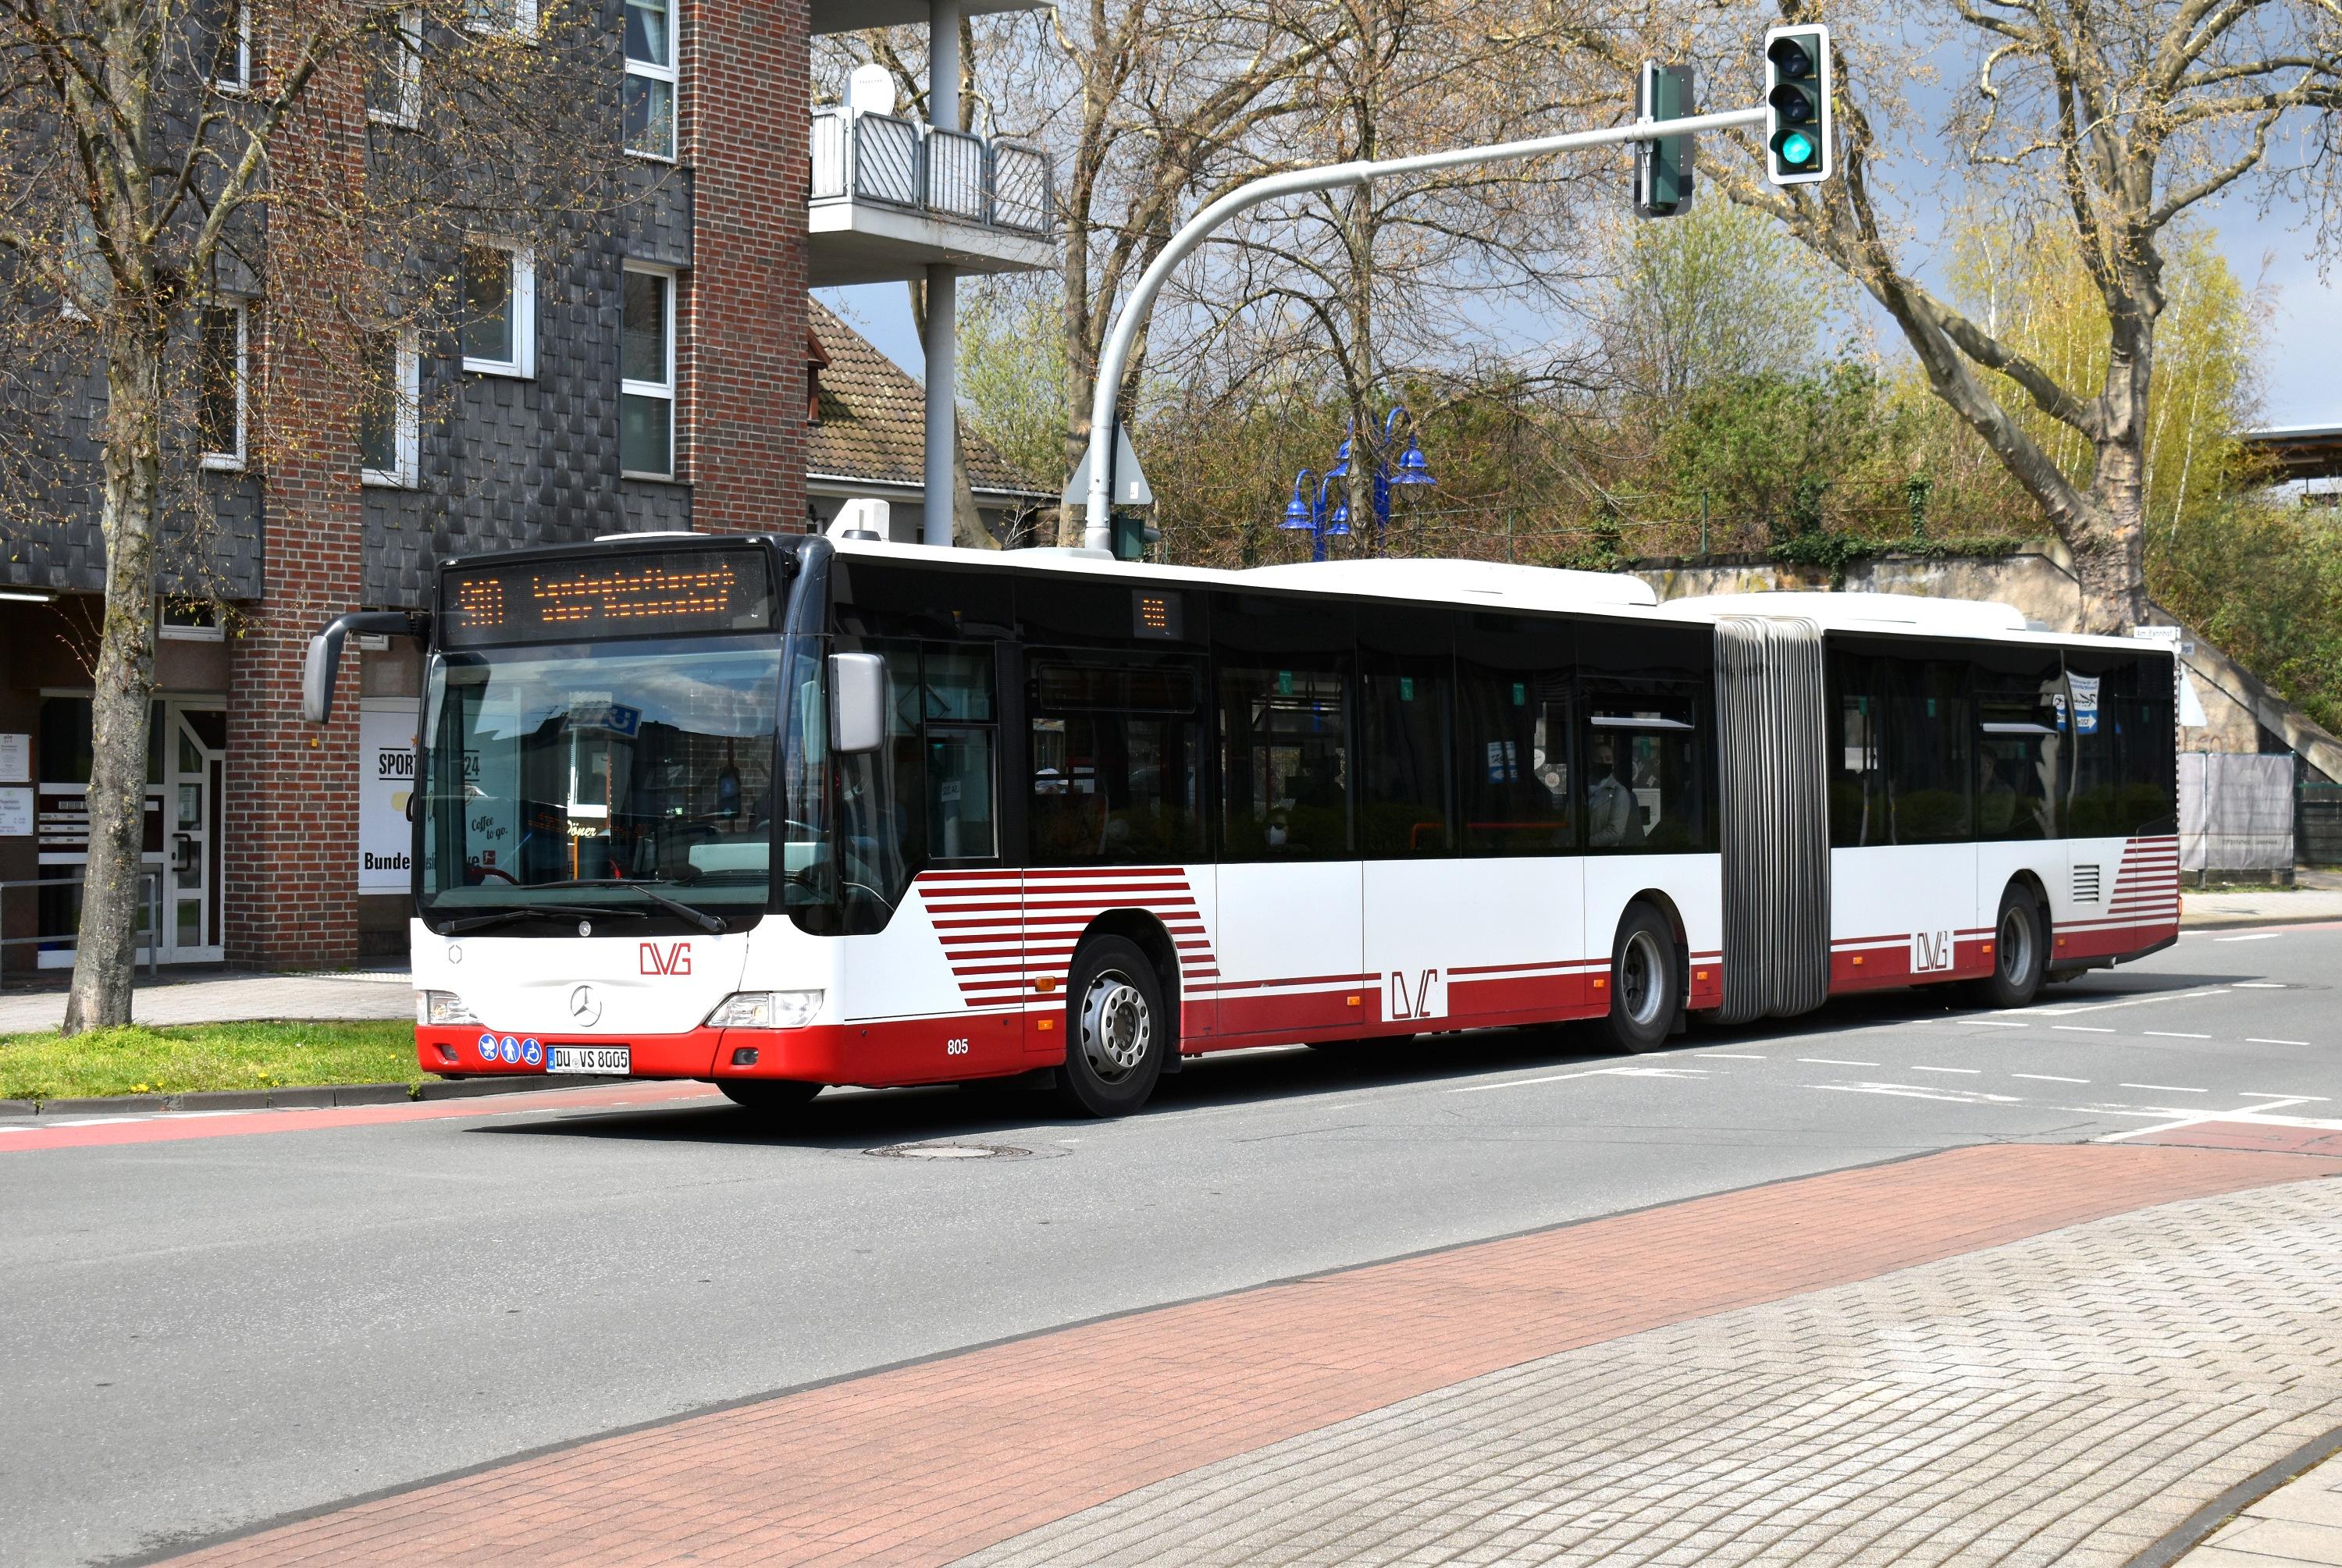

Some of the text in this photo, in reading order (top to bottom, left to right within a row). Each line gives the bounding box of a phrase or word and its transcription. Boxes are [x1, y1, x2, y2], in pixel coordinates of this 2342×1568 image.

[2148, 629, 2173, 638] Bahnhof
[379, 753, 416, 775] SPOR
[472, 816, 493, 833] Coffee
[486, 827, 494, 840] to
[640, 943, 691, 975] DVG
[1917, 931, 1948, 971] DVG
[947, 1039, 969, 1055] 805
[556, 1051, 570, 1067] DU
[580, 1051, 594, 1068] VS
[598, 1051, 628, 1068] 8005
